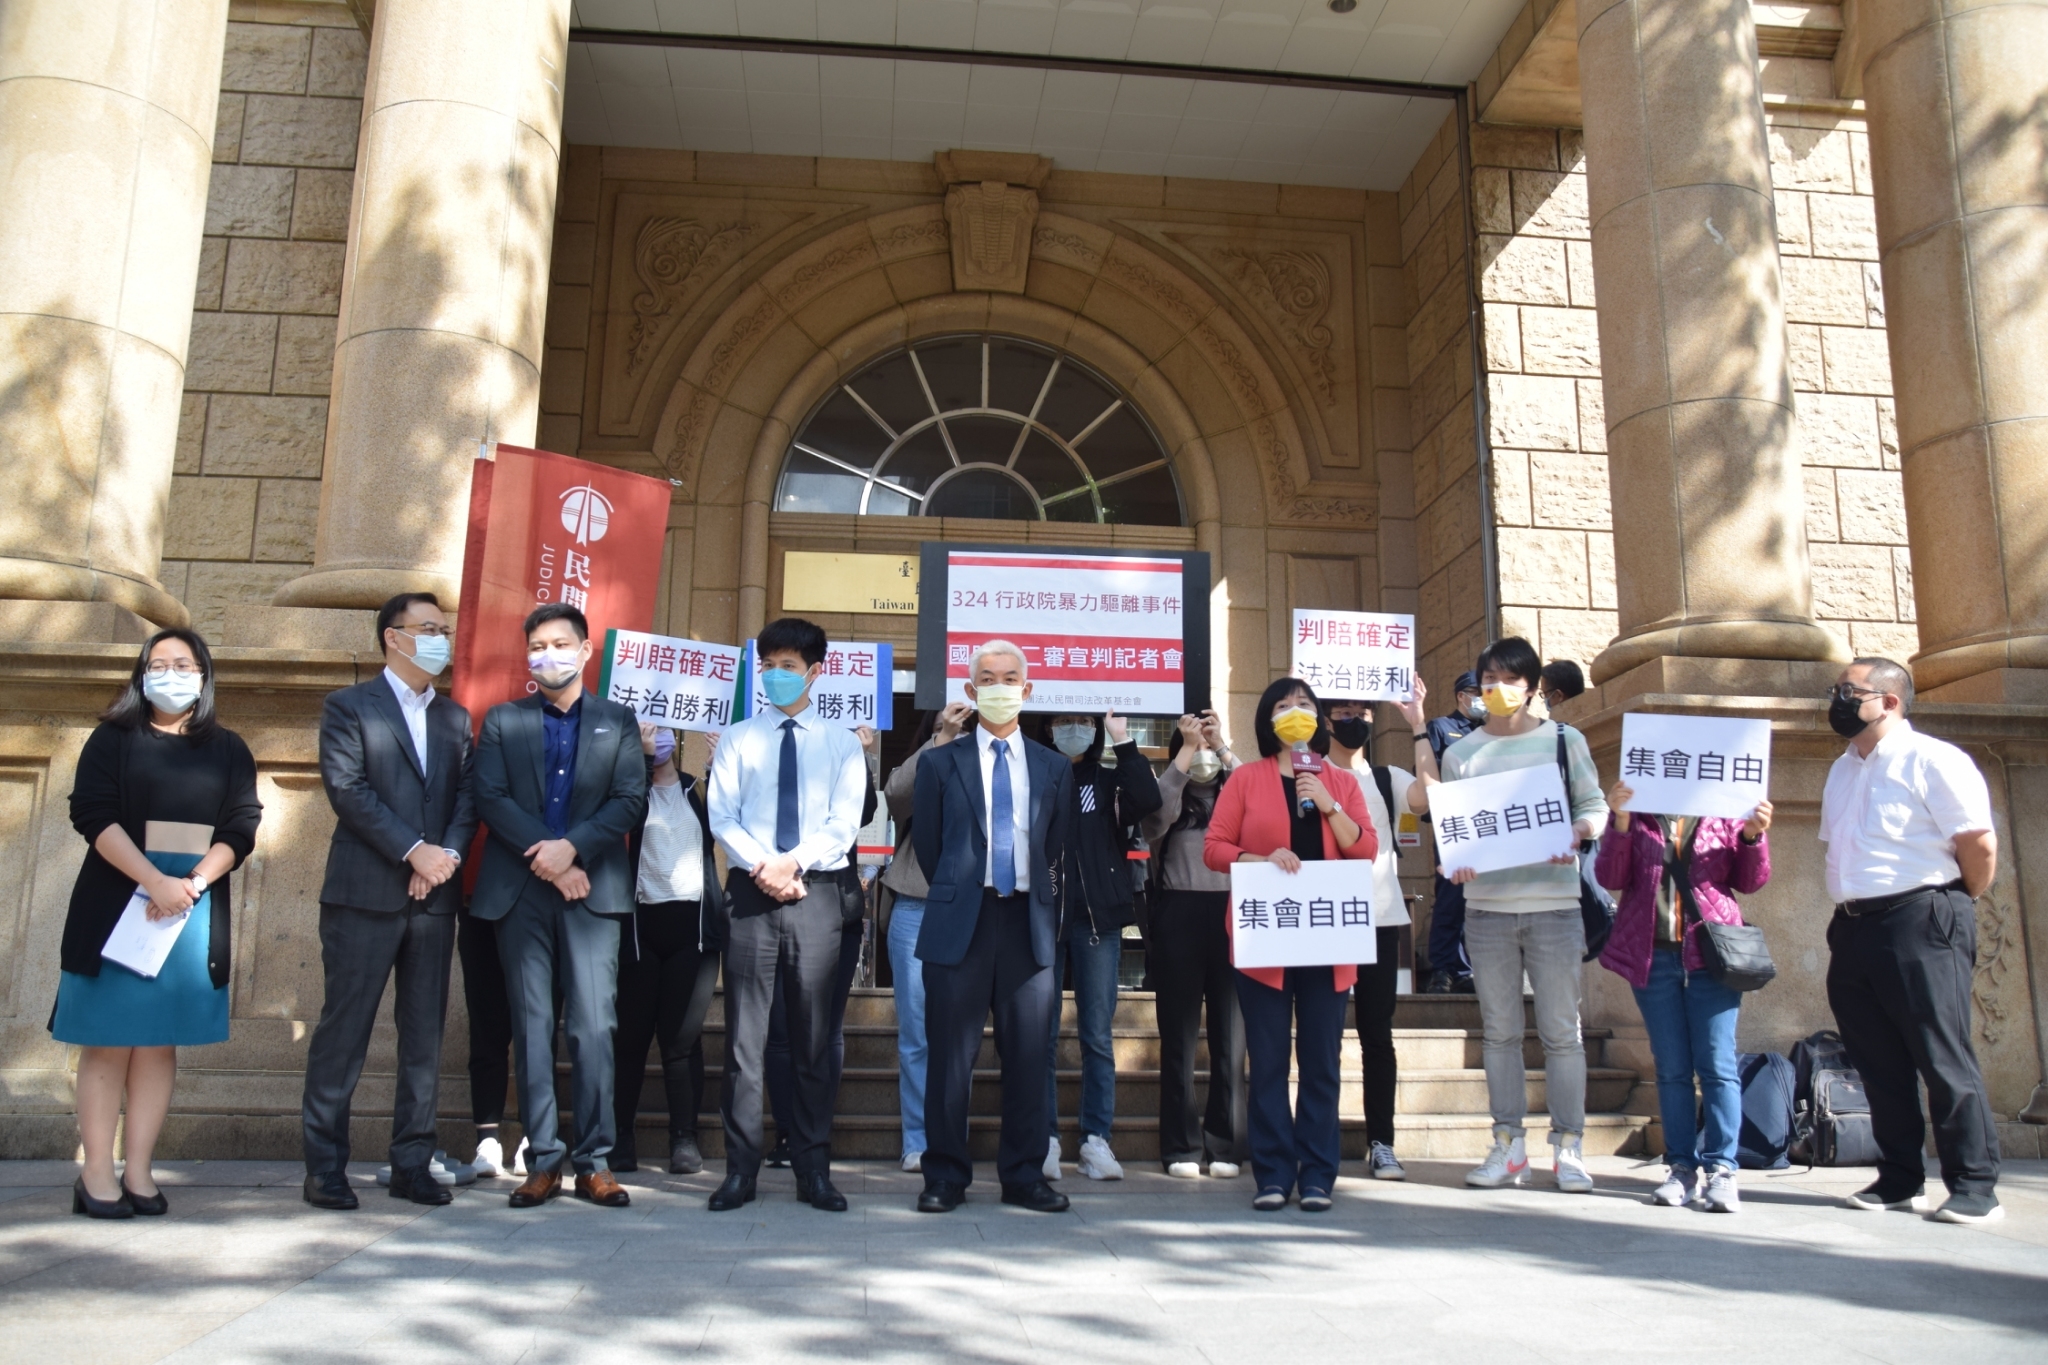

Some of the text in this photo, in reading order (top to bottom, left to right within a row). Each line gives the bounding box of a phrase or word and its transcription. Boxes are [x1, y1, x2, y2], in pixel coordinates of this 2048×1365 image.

[870, 598, 915, 611] Taiwan
[952, 590, 1182, 615] 324 行政院暴力驅離事件
[1298, 618, 1410, 650] 判賠確定
[617, 639, 736, 683] 判賠確定
[949, 644, 1183, 671] 國二審宣判記者會
[1298, 661, 1410, 693] 法治勝利
[1625, 746, 1763, 784] 集會自由
[1439, 797, 1565, 845] 集會自由
[1238, 896, 1370, 930] 集會自由
